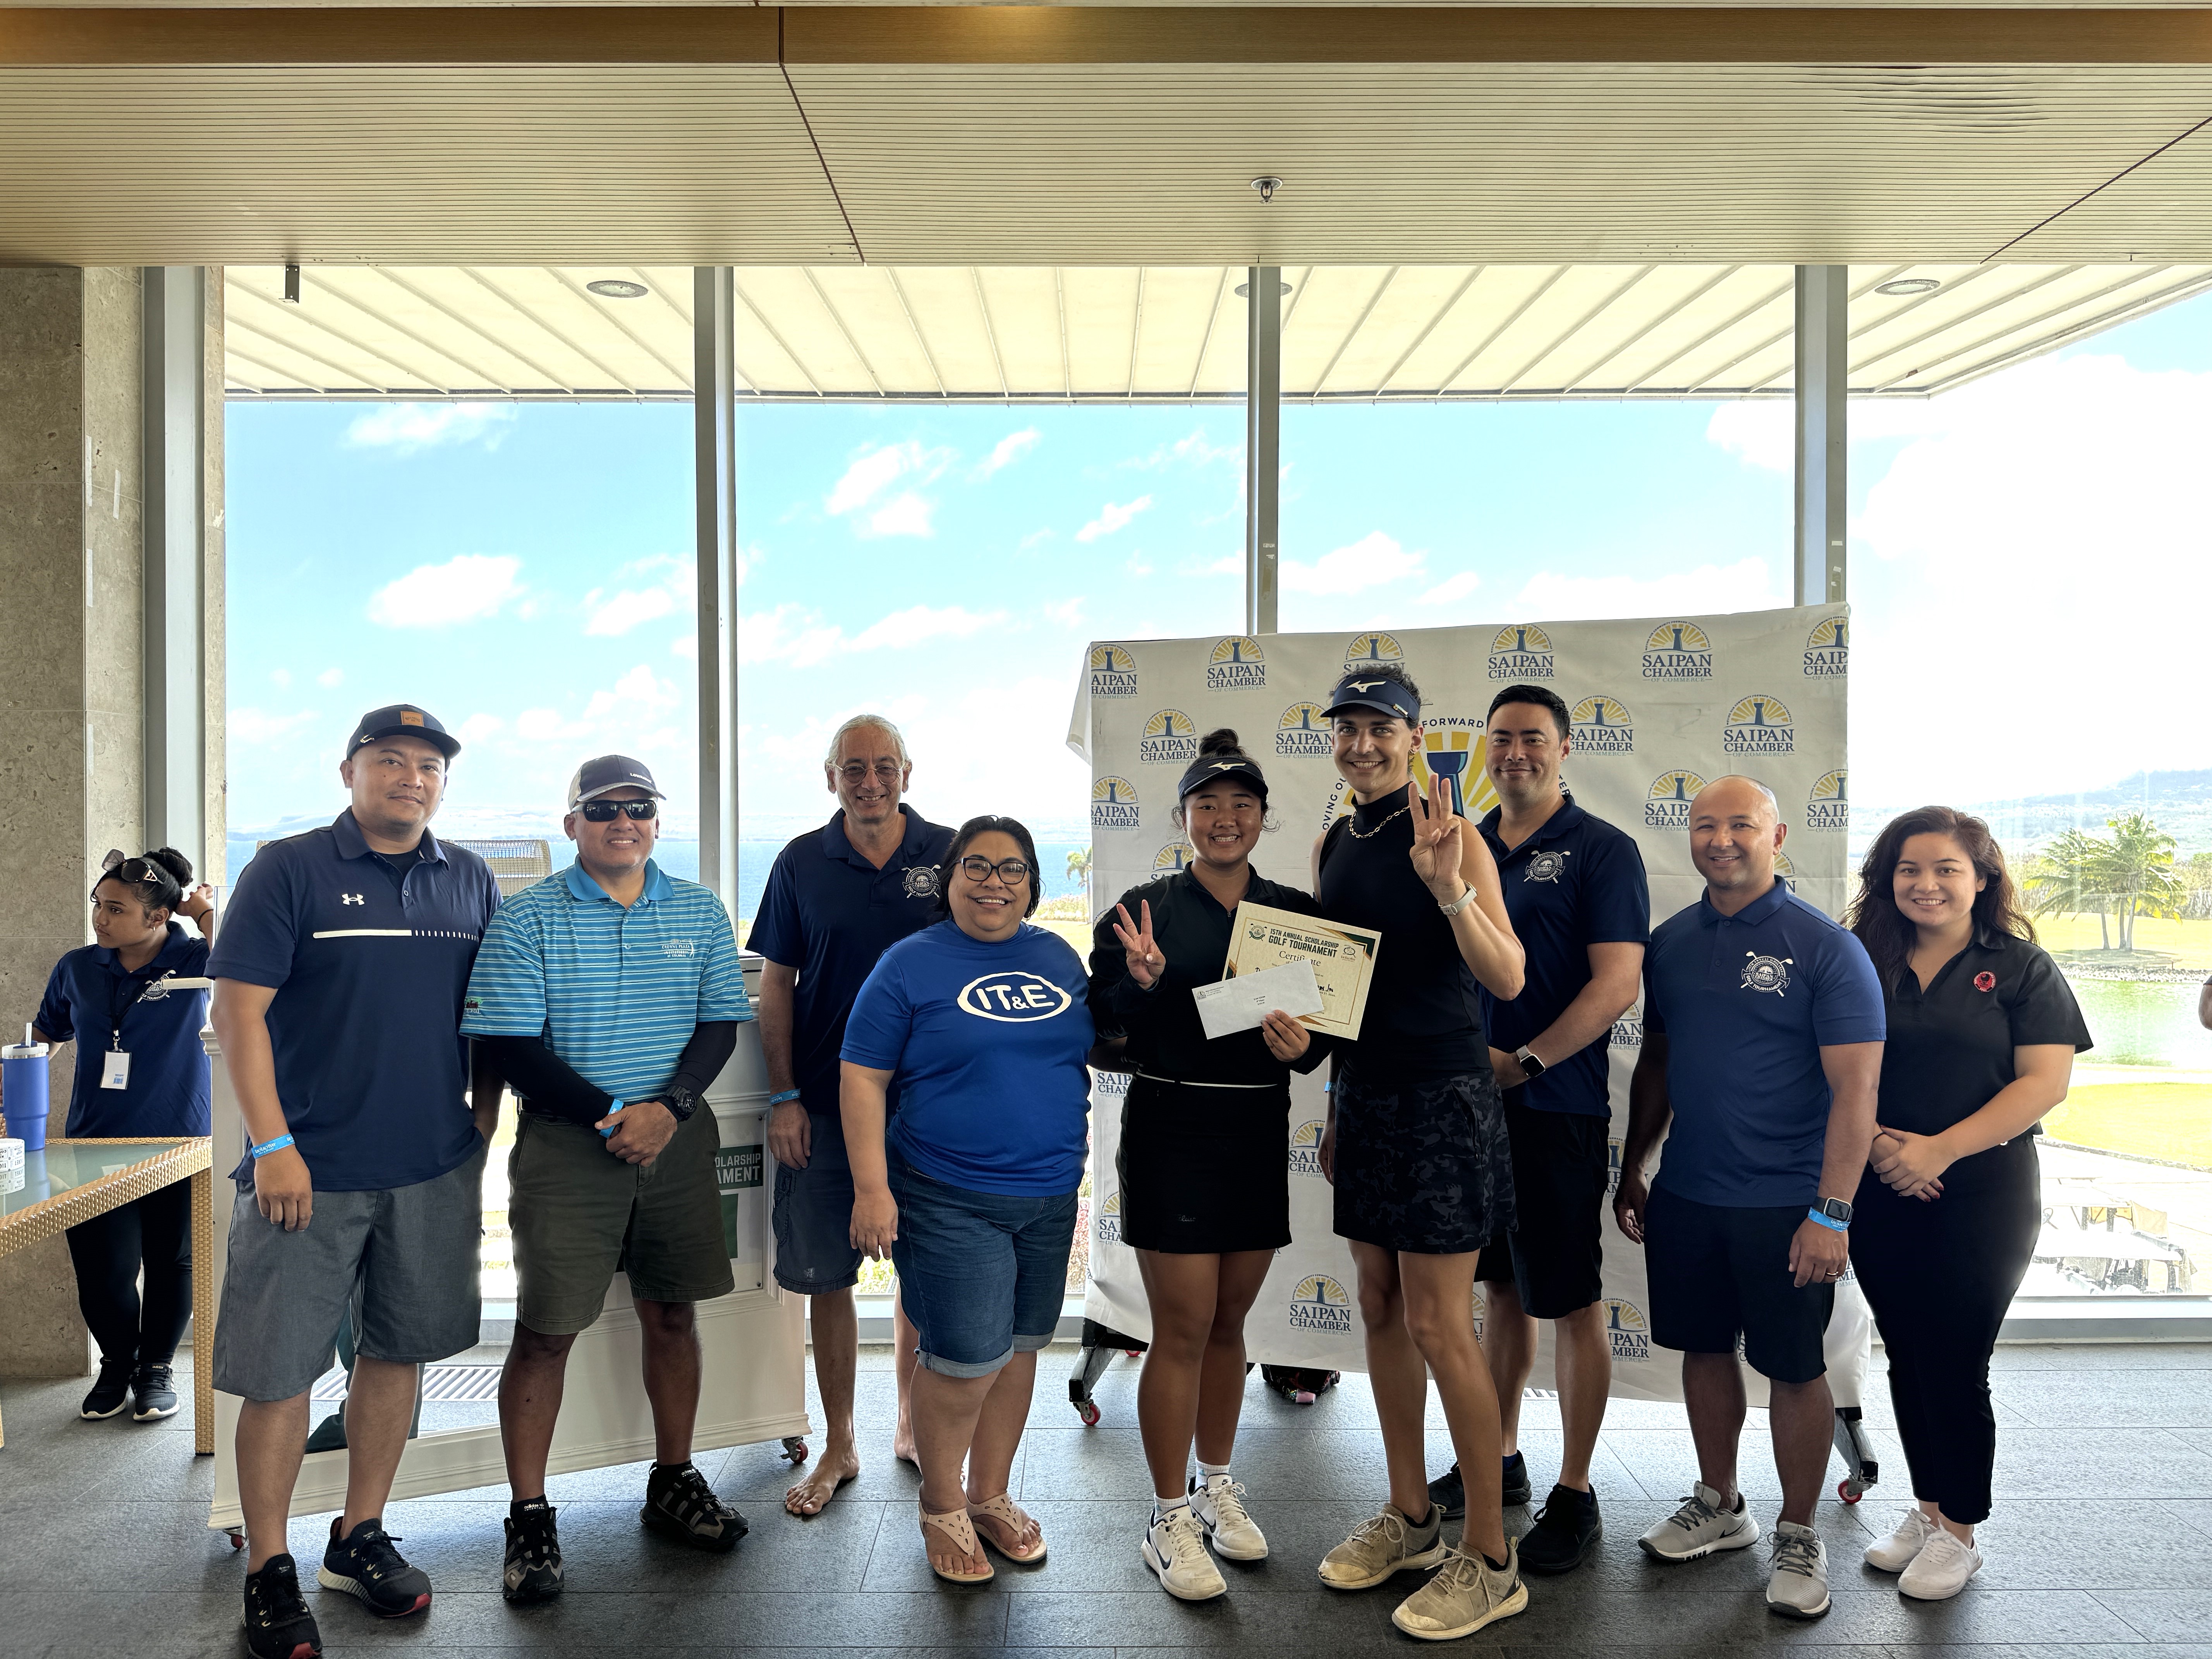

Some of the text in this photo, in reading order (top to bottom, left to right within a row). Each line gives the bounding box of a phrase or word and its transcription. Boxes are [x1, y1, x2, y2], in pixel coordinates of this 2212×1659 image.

[1488, 655, 1554, 669] SAIPAN
[1642, 654, 1712, 667] SAIPAN
[1804, 651, 1848, 665] SAIP
[1207, 665, 1266, 679] SAIPAN
[1488, 668, 1554, 678] CHAMBER
[1643, 668, 1712, 677] CHAMBER
[1804, 665, 1848, 675] CHAM
[1091, 674, 1138, 685] AIPAN
[1207, 677, 1266, 688] CHAMBER
[1091, 686, 1137, 694] HAMBER
[1422, 718, 1484, 728] FORWARD
[1570, 728, 1634, 741] SAIPAN
[1724, 729, 1794, 742] SAIPAN
[1141, 738, 1197, 752] SAIPAN
[1724, 743, 1795, 752] CHAMBER
[1141, 751, 1197, 761] CHAMBER
[1322, 778, 1346, 830] OVING OU
[1645, 804, 1690, 816] SAIP
[1807, 804, 1848, 817] SAIP
[1645, 816, 1689, 826] CHAM
[1807, 818, 1848, 827] CHAM
[1269, 935, 1337, 958] GOLF TOURNAMENT
[1283, 932, 1303, 941] ANNUAL
[1305, 936, 1339, 949] SCHOLARSHIP
[976, 984, 1055, 1010] IT&E
[1612, 1023, 1642, 1036] PAN
[1611, 1036, 1642, 1046] MBER
[1097, 1072, 1131, 1085] SAIP
[1098, 1084, 1127, 1094] CHAM
[714, 1153, 761, 1167] OLARSHIP
[1290, 1150, 1319, 1163] SAI
[1290, 1163, 1323, 1173] CHAM
[1290, 1304, 1351, 1322] SAIPAN
[1290, 1317, 1351, 1331] CHAMBER
[1609, 1333, 1649, 1348] IPAN
[1612, 1346, 1649, 1358] MBER
